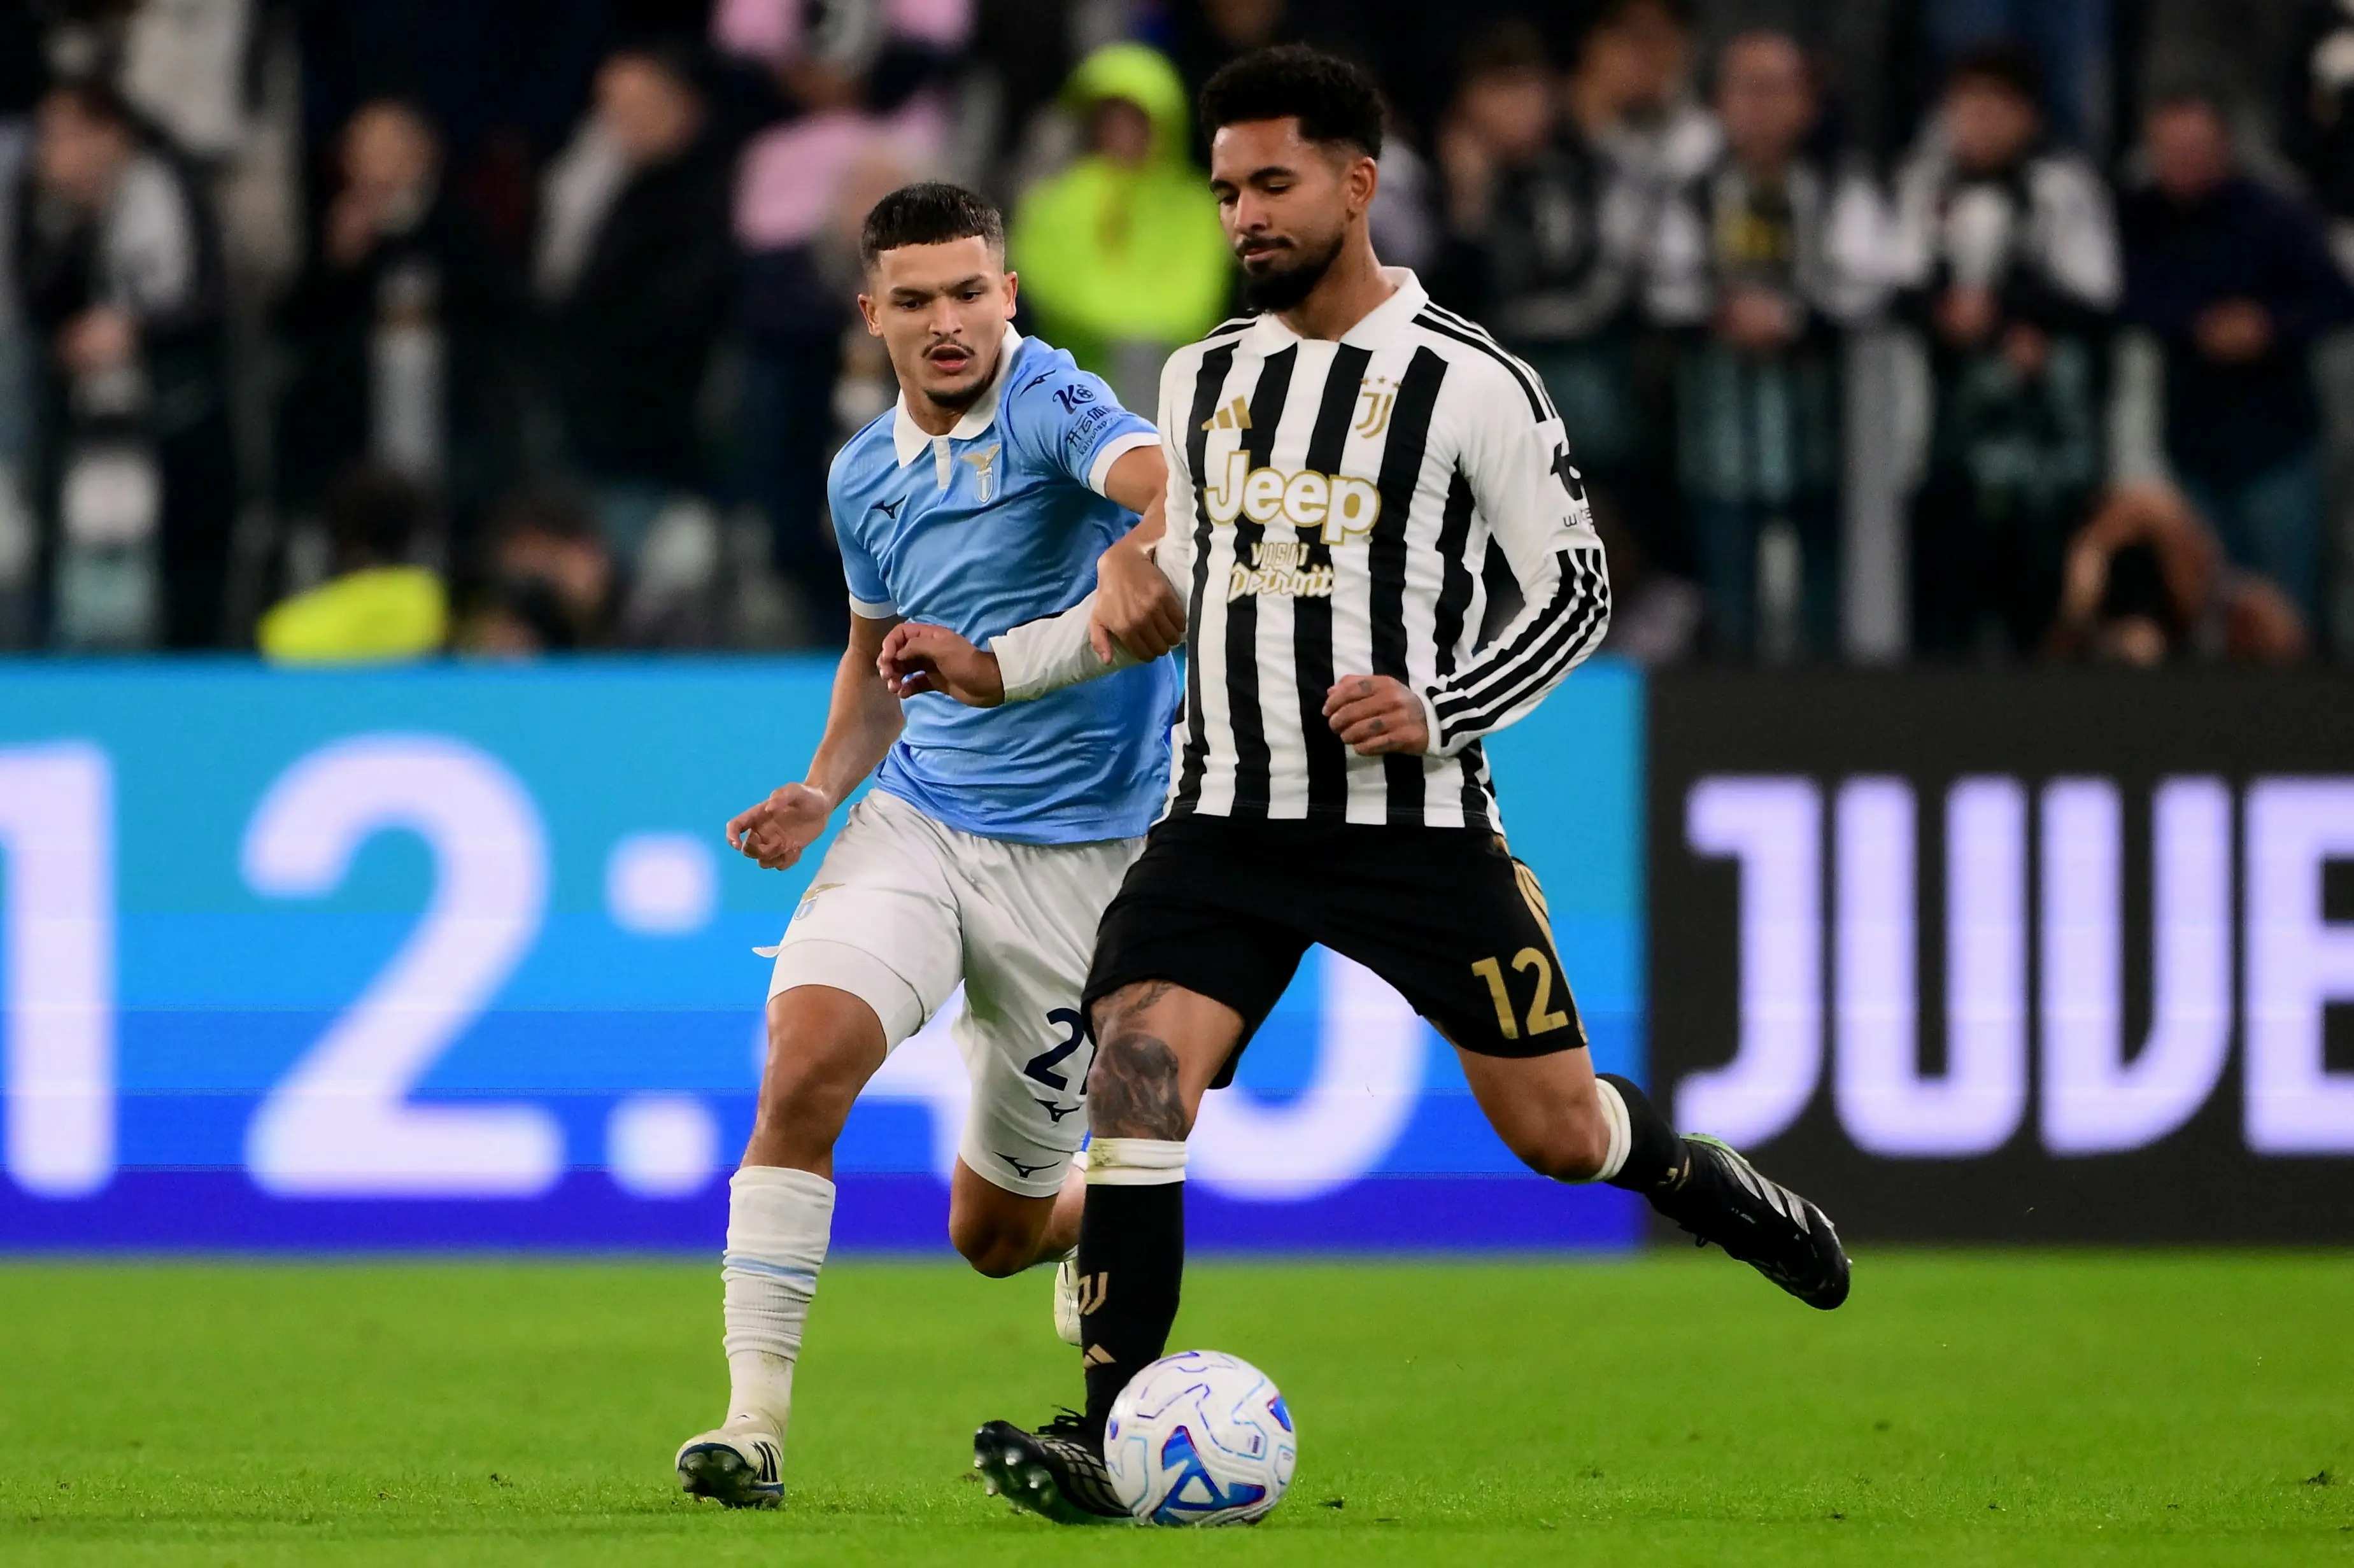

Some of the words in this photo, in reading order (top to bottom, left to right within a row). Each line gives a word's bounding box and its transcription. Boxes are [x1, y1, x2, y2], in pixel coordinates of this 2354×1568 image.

[1203, 449, 1382, 546] Jeep
[1227, 562, 1335, 604] Detroit
[1251, 542, 1310, 568] VISIT
[1471, 947, 1569, 1040] 12
[1675, 775, 2354, 1155] JUVE
[1023, 1007, 1094, 1095] 2
